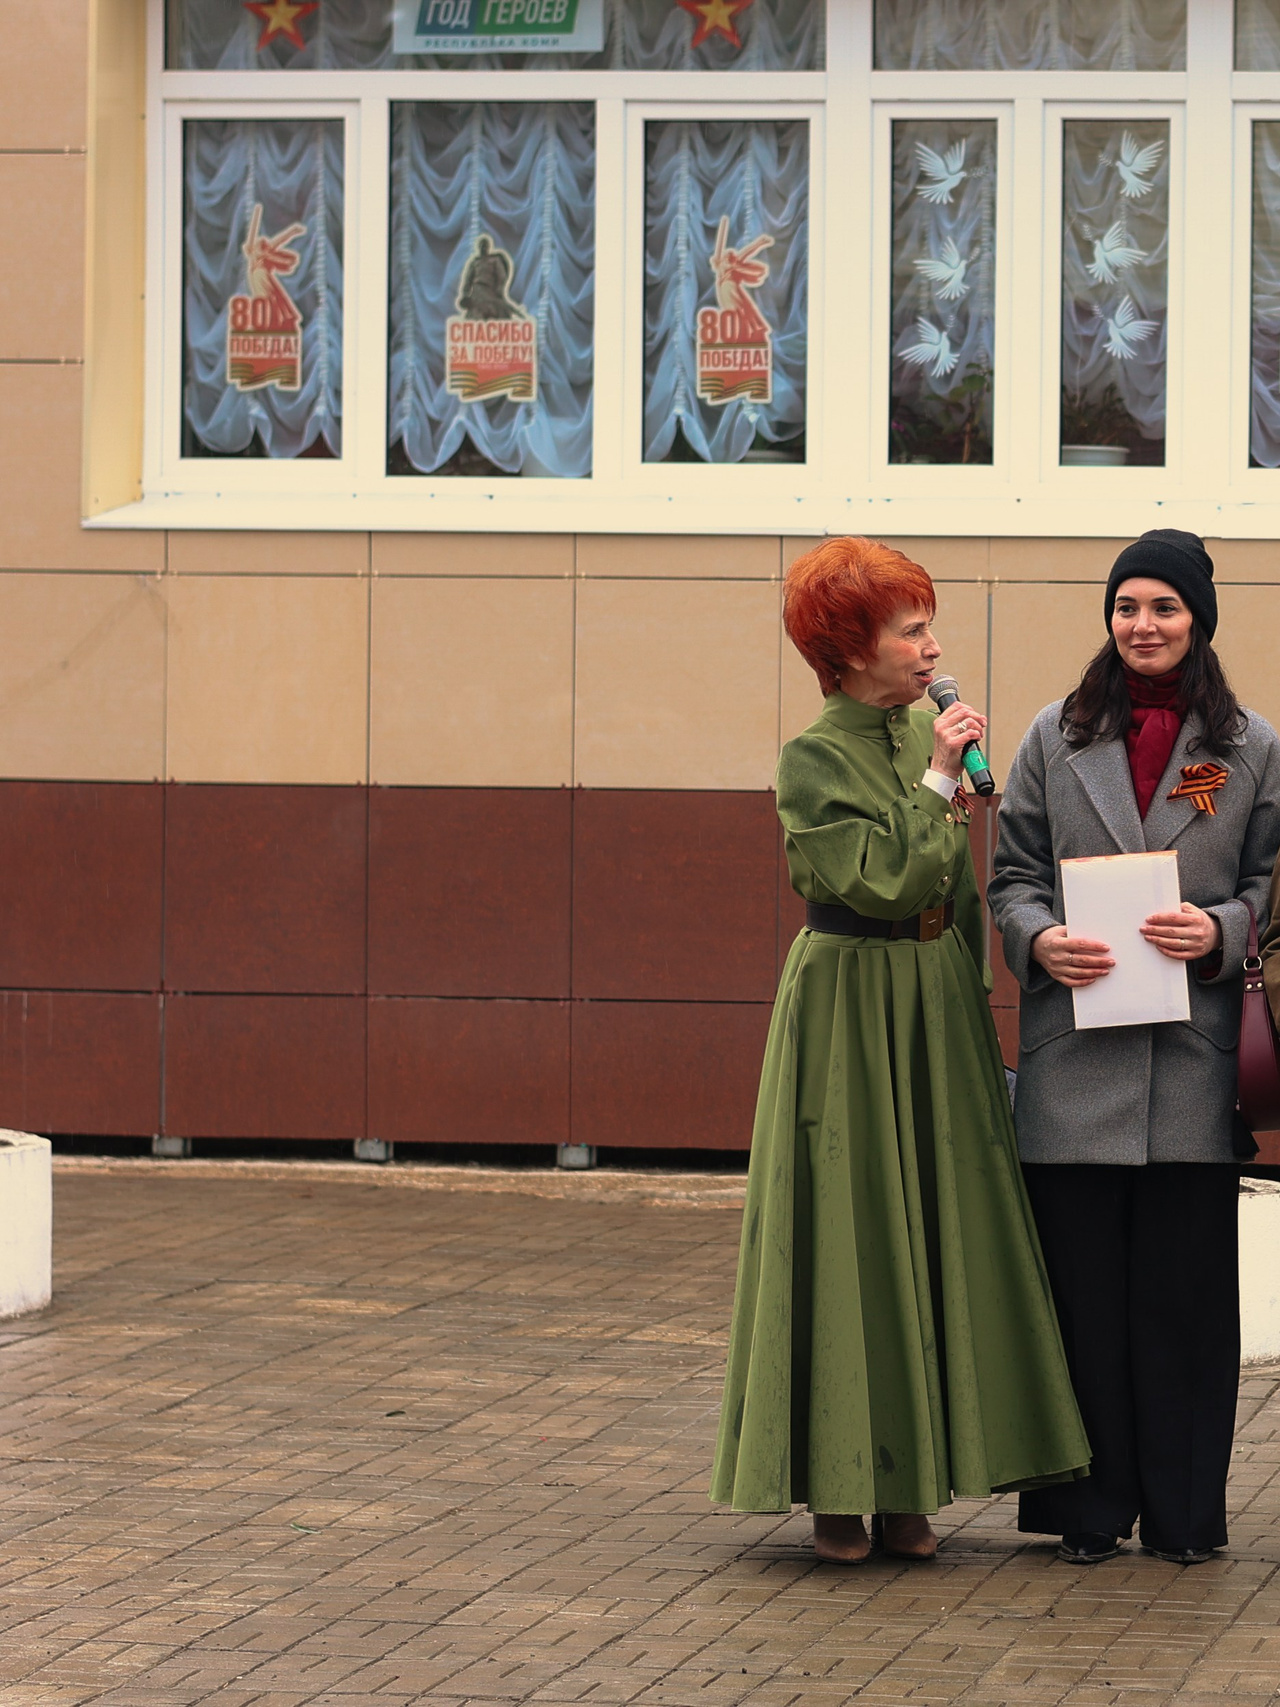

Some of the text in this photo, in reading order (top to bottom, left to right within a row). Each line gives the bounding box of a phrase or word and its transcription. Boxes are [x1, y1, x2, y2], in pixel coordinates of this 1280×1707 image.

[425, 0, 569, 29] ГОД ГЕРОЕВ
[424, 38, 560, 48] РЕСПУБЛИКА КОМИ
[232, 297, 269, 331] 80
[450, 322, 533, 342] СПАСИБО
[701, 310, 738, 344] 80
[450, 345, 468, 362] ЗА
[701, 350, 769, 371] ПОБЕДА!
